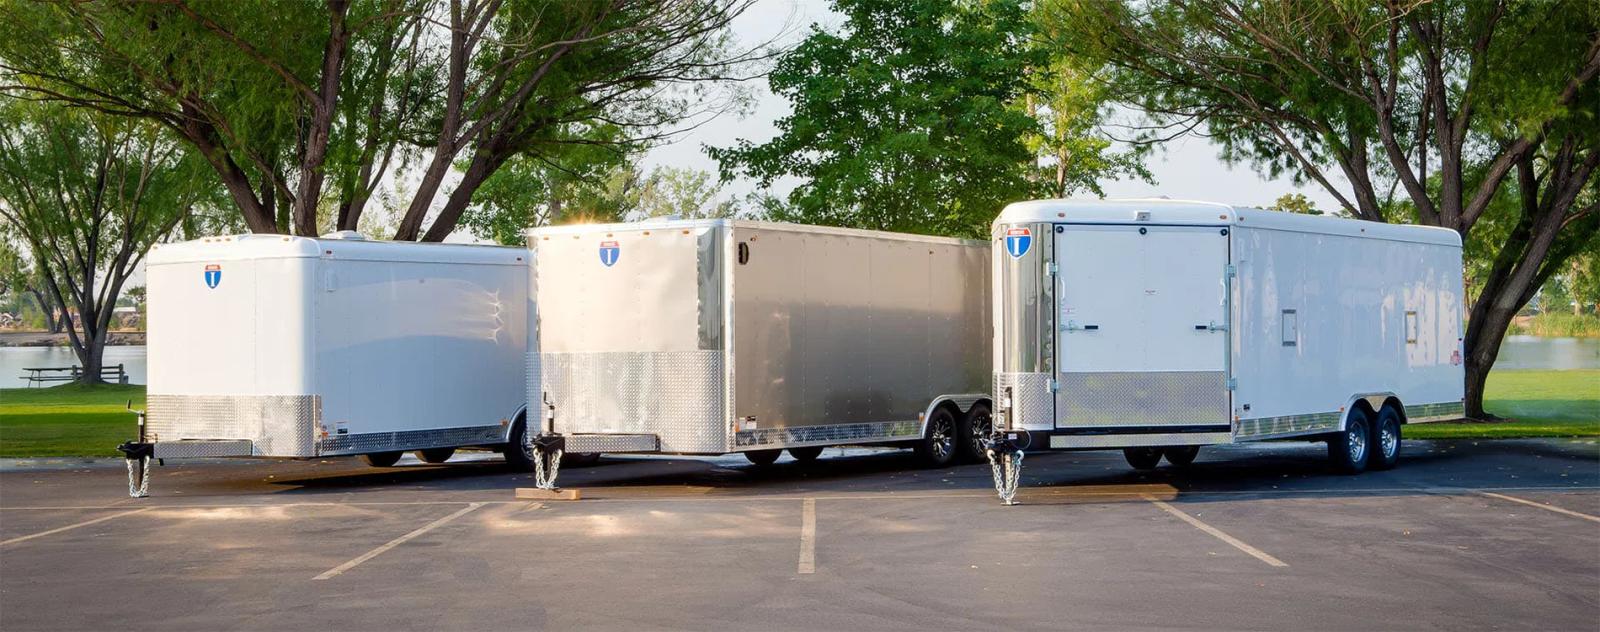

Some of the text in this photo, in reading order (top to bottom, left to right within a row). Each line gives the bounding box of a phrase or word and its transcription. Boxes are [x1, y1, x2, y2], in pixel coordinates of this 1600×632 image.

[1013, 238, 1020, 255] I
[606, 249, 612, 265] I
[210, 271, 215, 287] I
